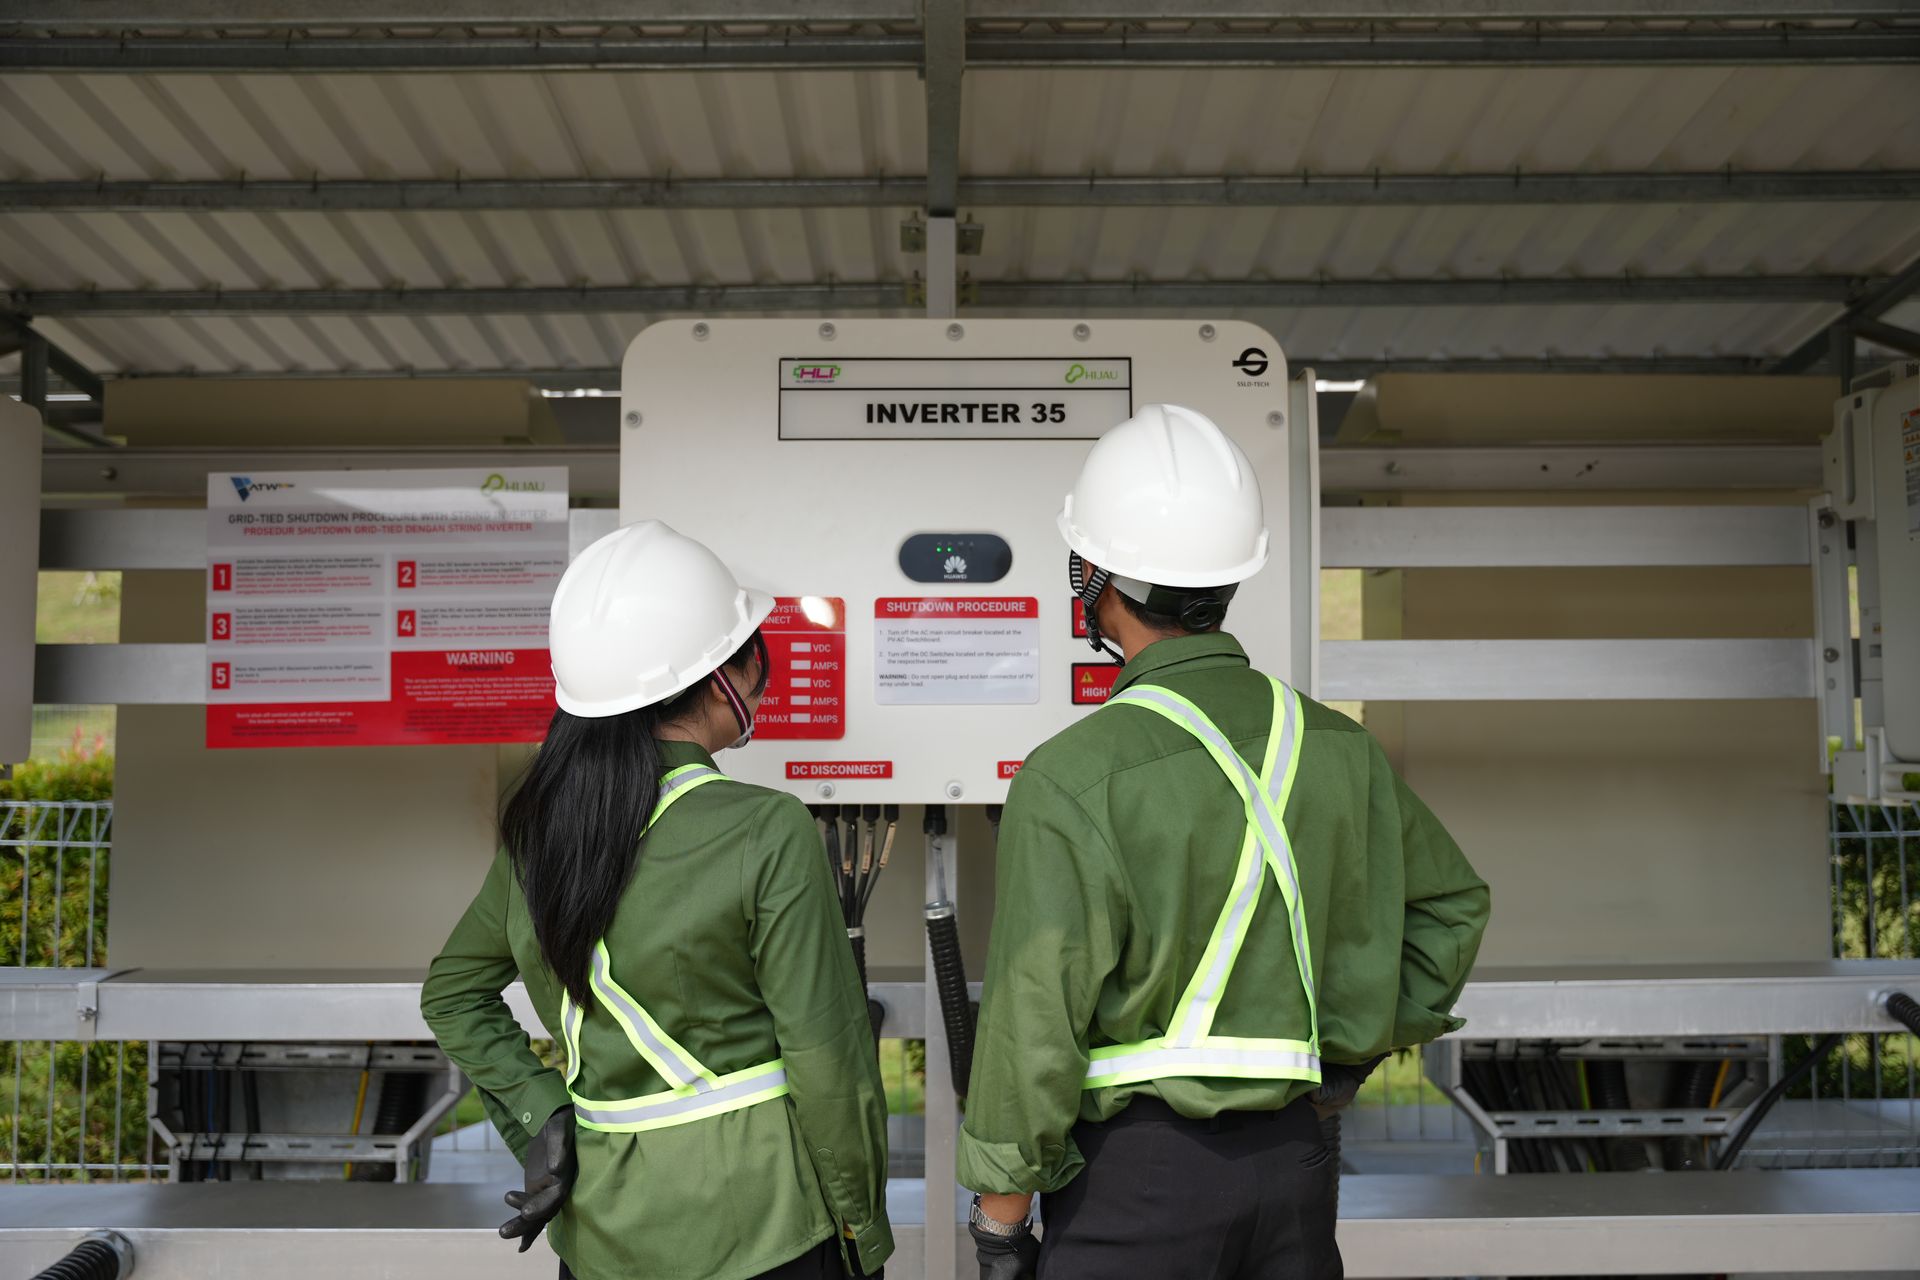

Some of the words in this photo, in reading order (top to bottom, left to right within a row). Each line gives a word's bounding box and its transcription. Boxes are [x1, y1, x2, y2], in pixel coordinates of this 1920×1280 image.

[1084, 370, 1119, 380] HIJAU
[866, 403, 1021, 424] INVERTER
[1031, 403, 1066, 424] 35
[228, 513, 284, 524] GRID-TIED
[287, 512, 349, 523] SHUTDOWN
[243, 526, 295, 537] PROSEDUR
[298, 525, 351, 535] SHUTDOWN
[354, 524, 401, 535] GRID-TIED
[405, 523, 446, 534] DENGAN
[447, 522, 483, 533] STRING
[485, 521, 533, 532] INVERTER
[401, 565, 412, 584] 2
[886, 601, 954, 612] SHUTDOWN
[956, 601, 1026, 612] PROCEDURE
[216, 617, 228, 636] 3
[400, 614, 413, 633] 4
[812, 643, 831, 653] VDC
[446, 651, 516, 666] WARNING
[812, 661, 838, 671] AMPS
[215, 666, 227, 685] 5
[812, 679, 831, 688] VDC
[1082, 687, 1107, 697] HIGH
[812, 696, 838, 706] AMPS
[768, 714, 789, 723] MAX
[812, 714, 838, 724] AMPS
[791, 764, 808, 776] DC
[810, 763, 886, 775] DISCONNECT
[1003, 764, 1020, 775] DC
